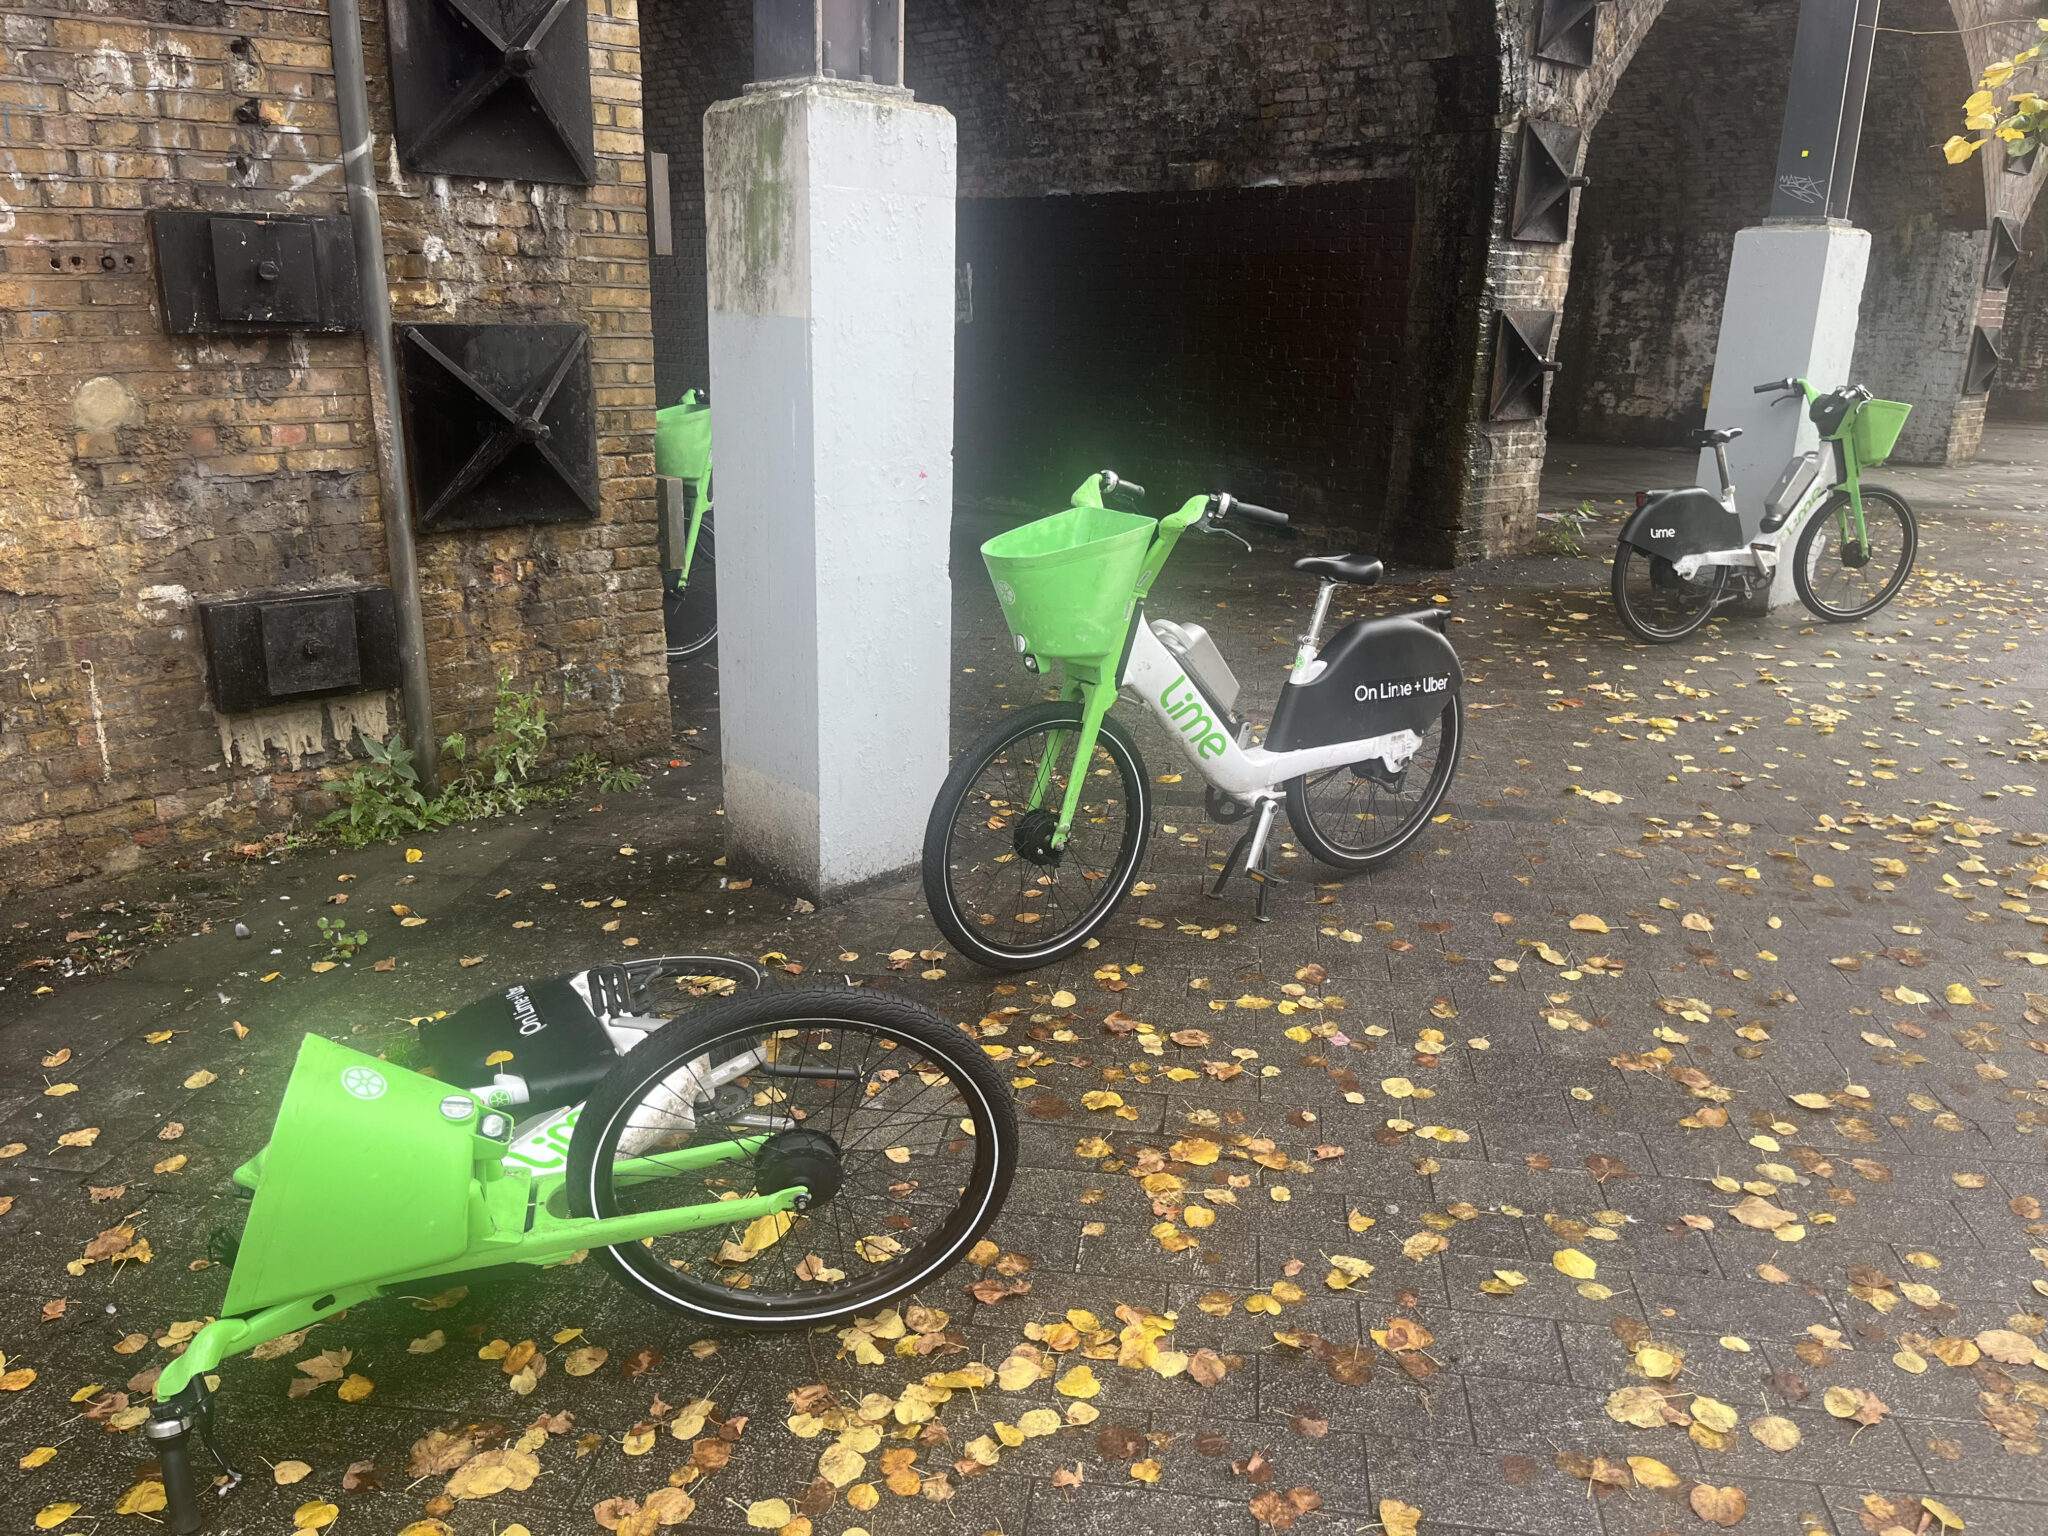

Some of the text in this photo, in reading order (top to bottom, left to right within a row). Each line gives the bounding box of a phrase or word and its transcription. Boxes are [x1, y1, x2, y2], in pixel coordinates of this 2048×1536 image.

[1650, 527, 1676, 539] Lime
[1354, 676, 1449, 701] On Lime + Uber
[1160, 674, 1227, 760] Lime
[519, 1014, 542, 1035] On
[507, 1110, 581, 1168] Lim
